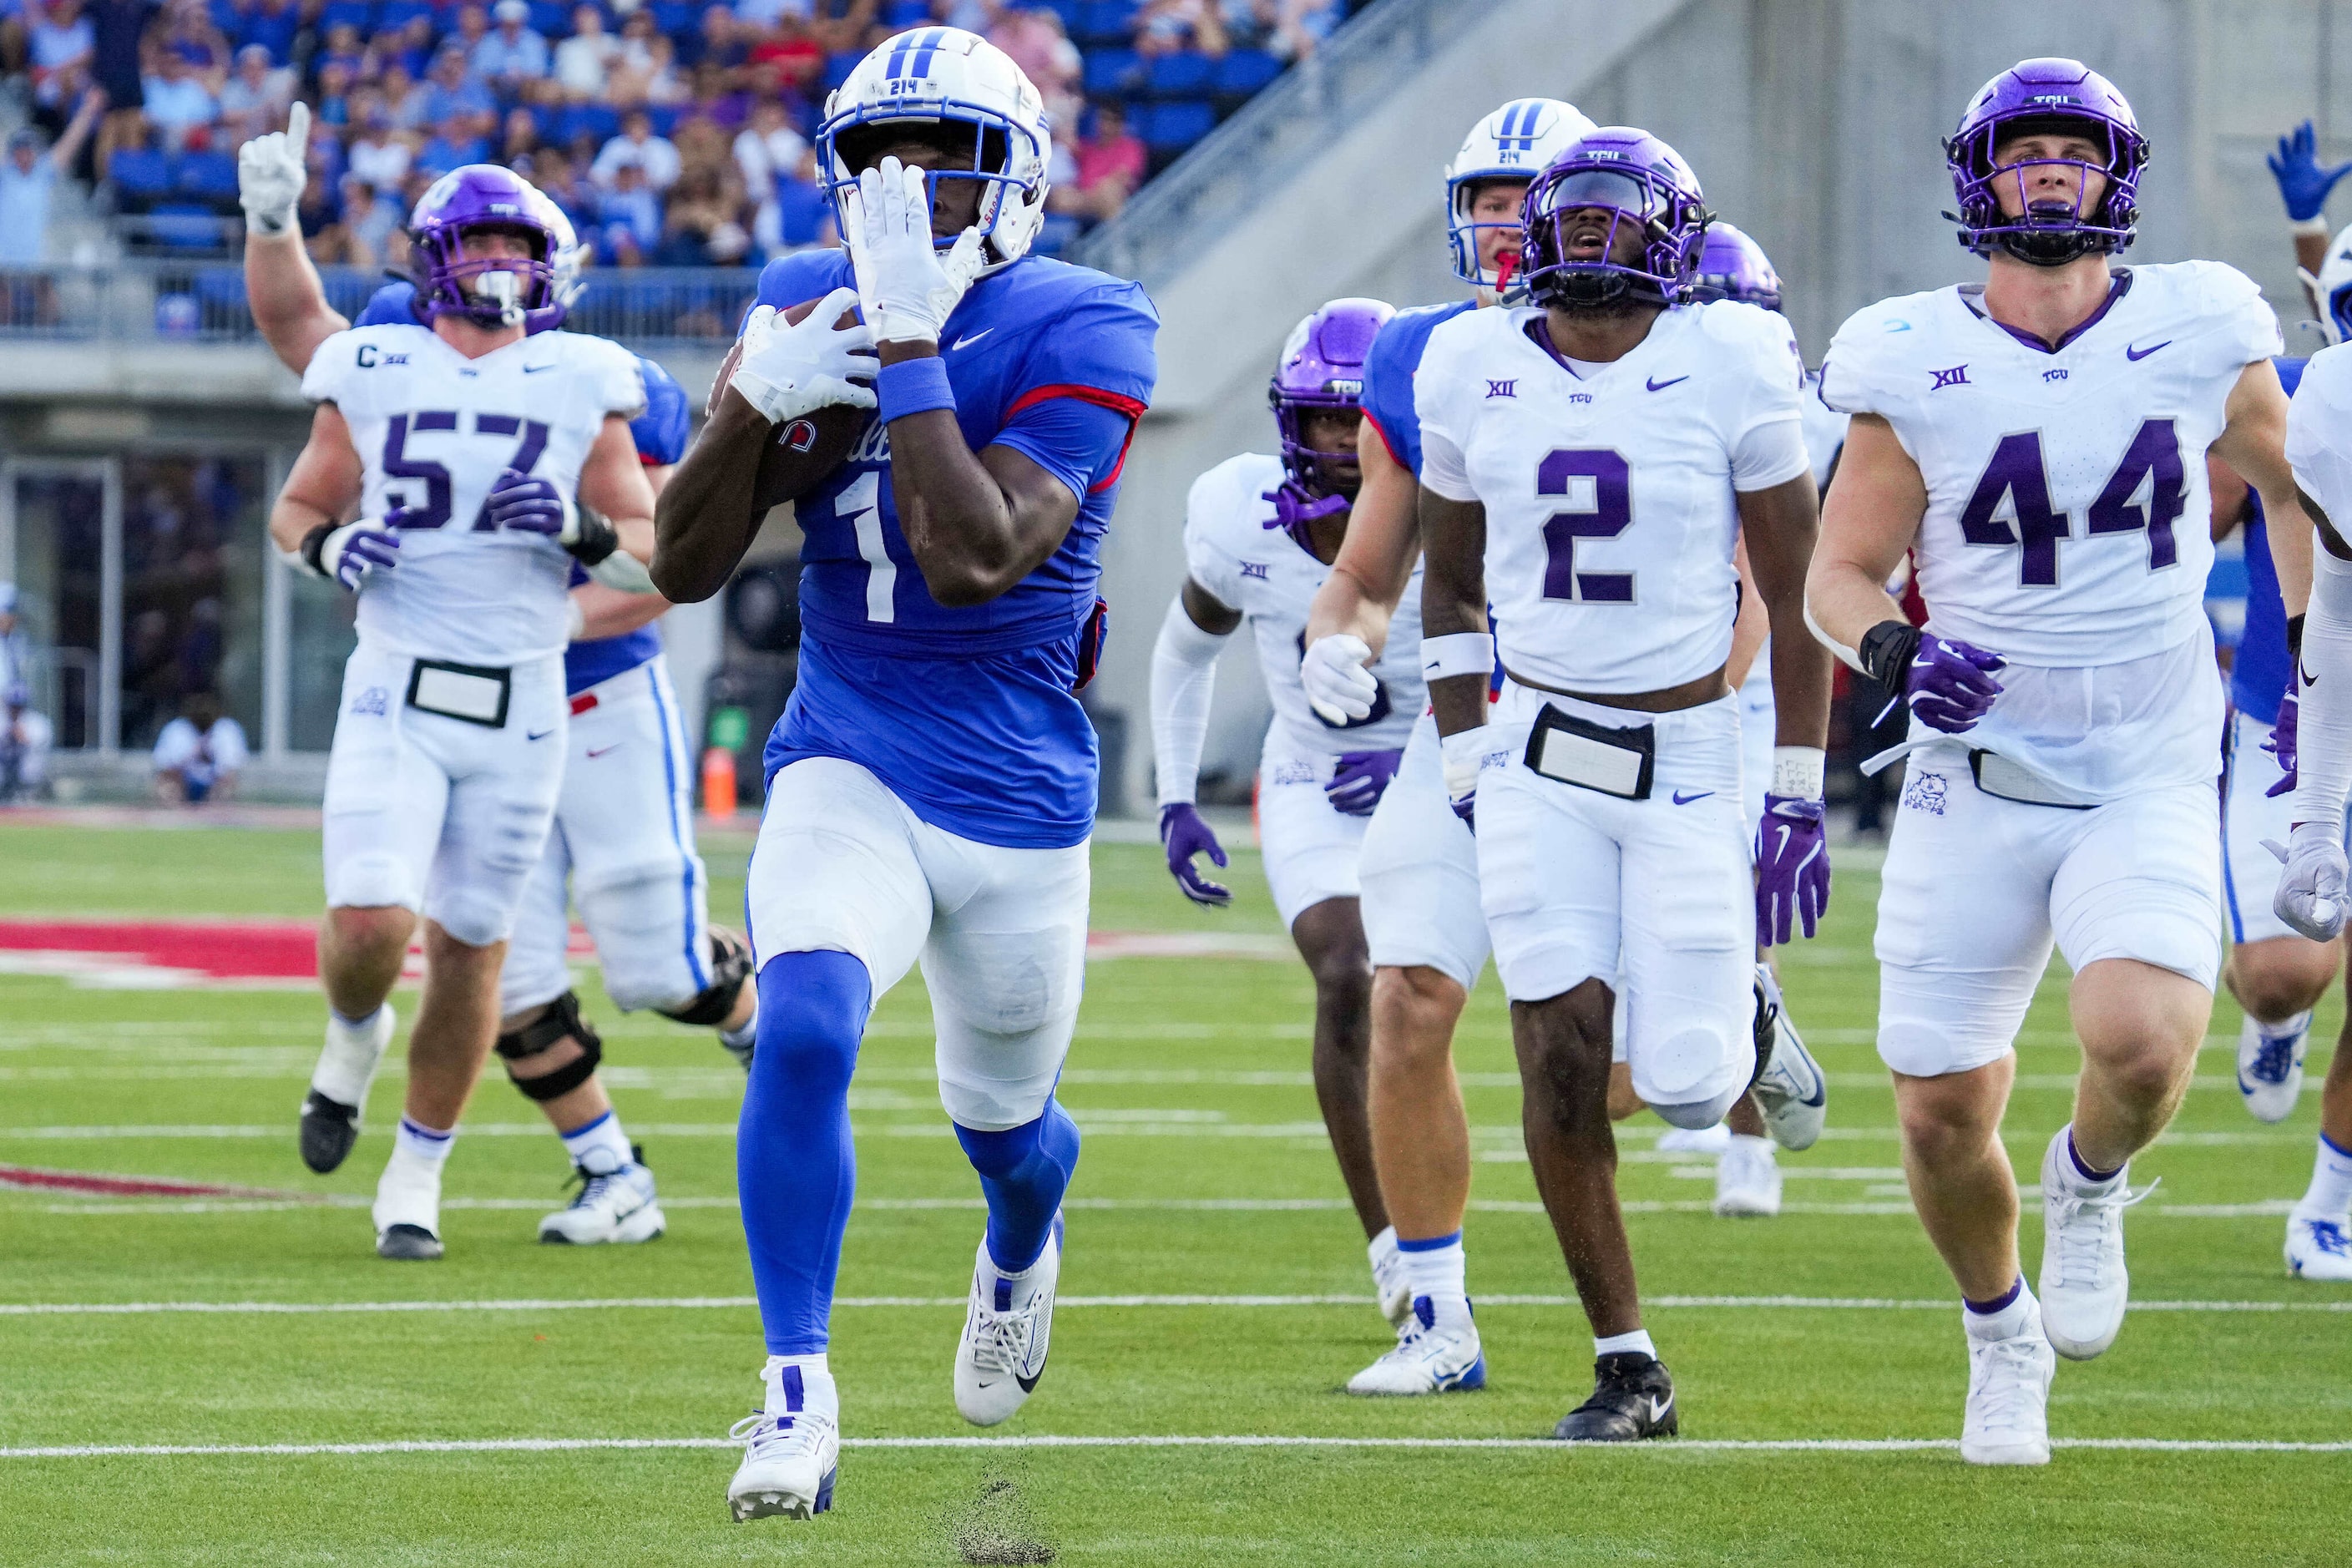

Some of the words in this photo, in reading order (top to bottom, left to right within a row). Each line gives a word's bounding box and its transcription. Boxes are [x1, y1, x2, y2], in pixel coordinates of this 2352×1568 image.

[890, 79, 918, 95] 214
[2033, 94, 2068, 104] TCU
[1499, 151, 1520, 164] 214
[1586, 150, 1619, 164] TCU
[357, 344, 377, 367] C
[1929, 363, 1971, 392] XII
[2042, 369, 2068, 382] TCU
[1331, 380, 1363, 393] TCU
[1485, 378, 1519, 399] XII
[1569, 392, 1593, 404] TCU
[382, 409, 550, 534] 57
[1958, 414, 2192, 589] 44
[1535, 446, 1637, 605] 2
[835, 471, 897, 623] 1
[1238, 559, 1270, 581] XII
